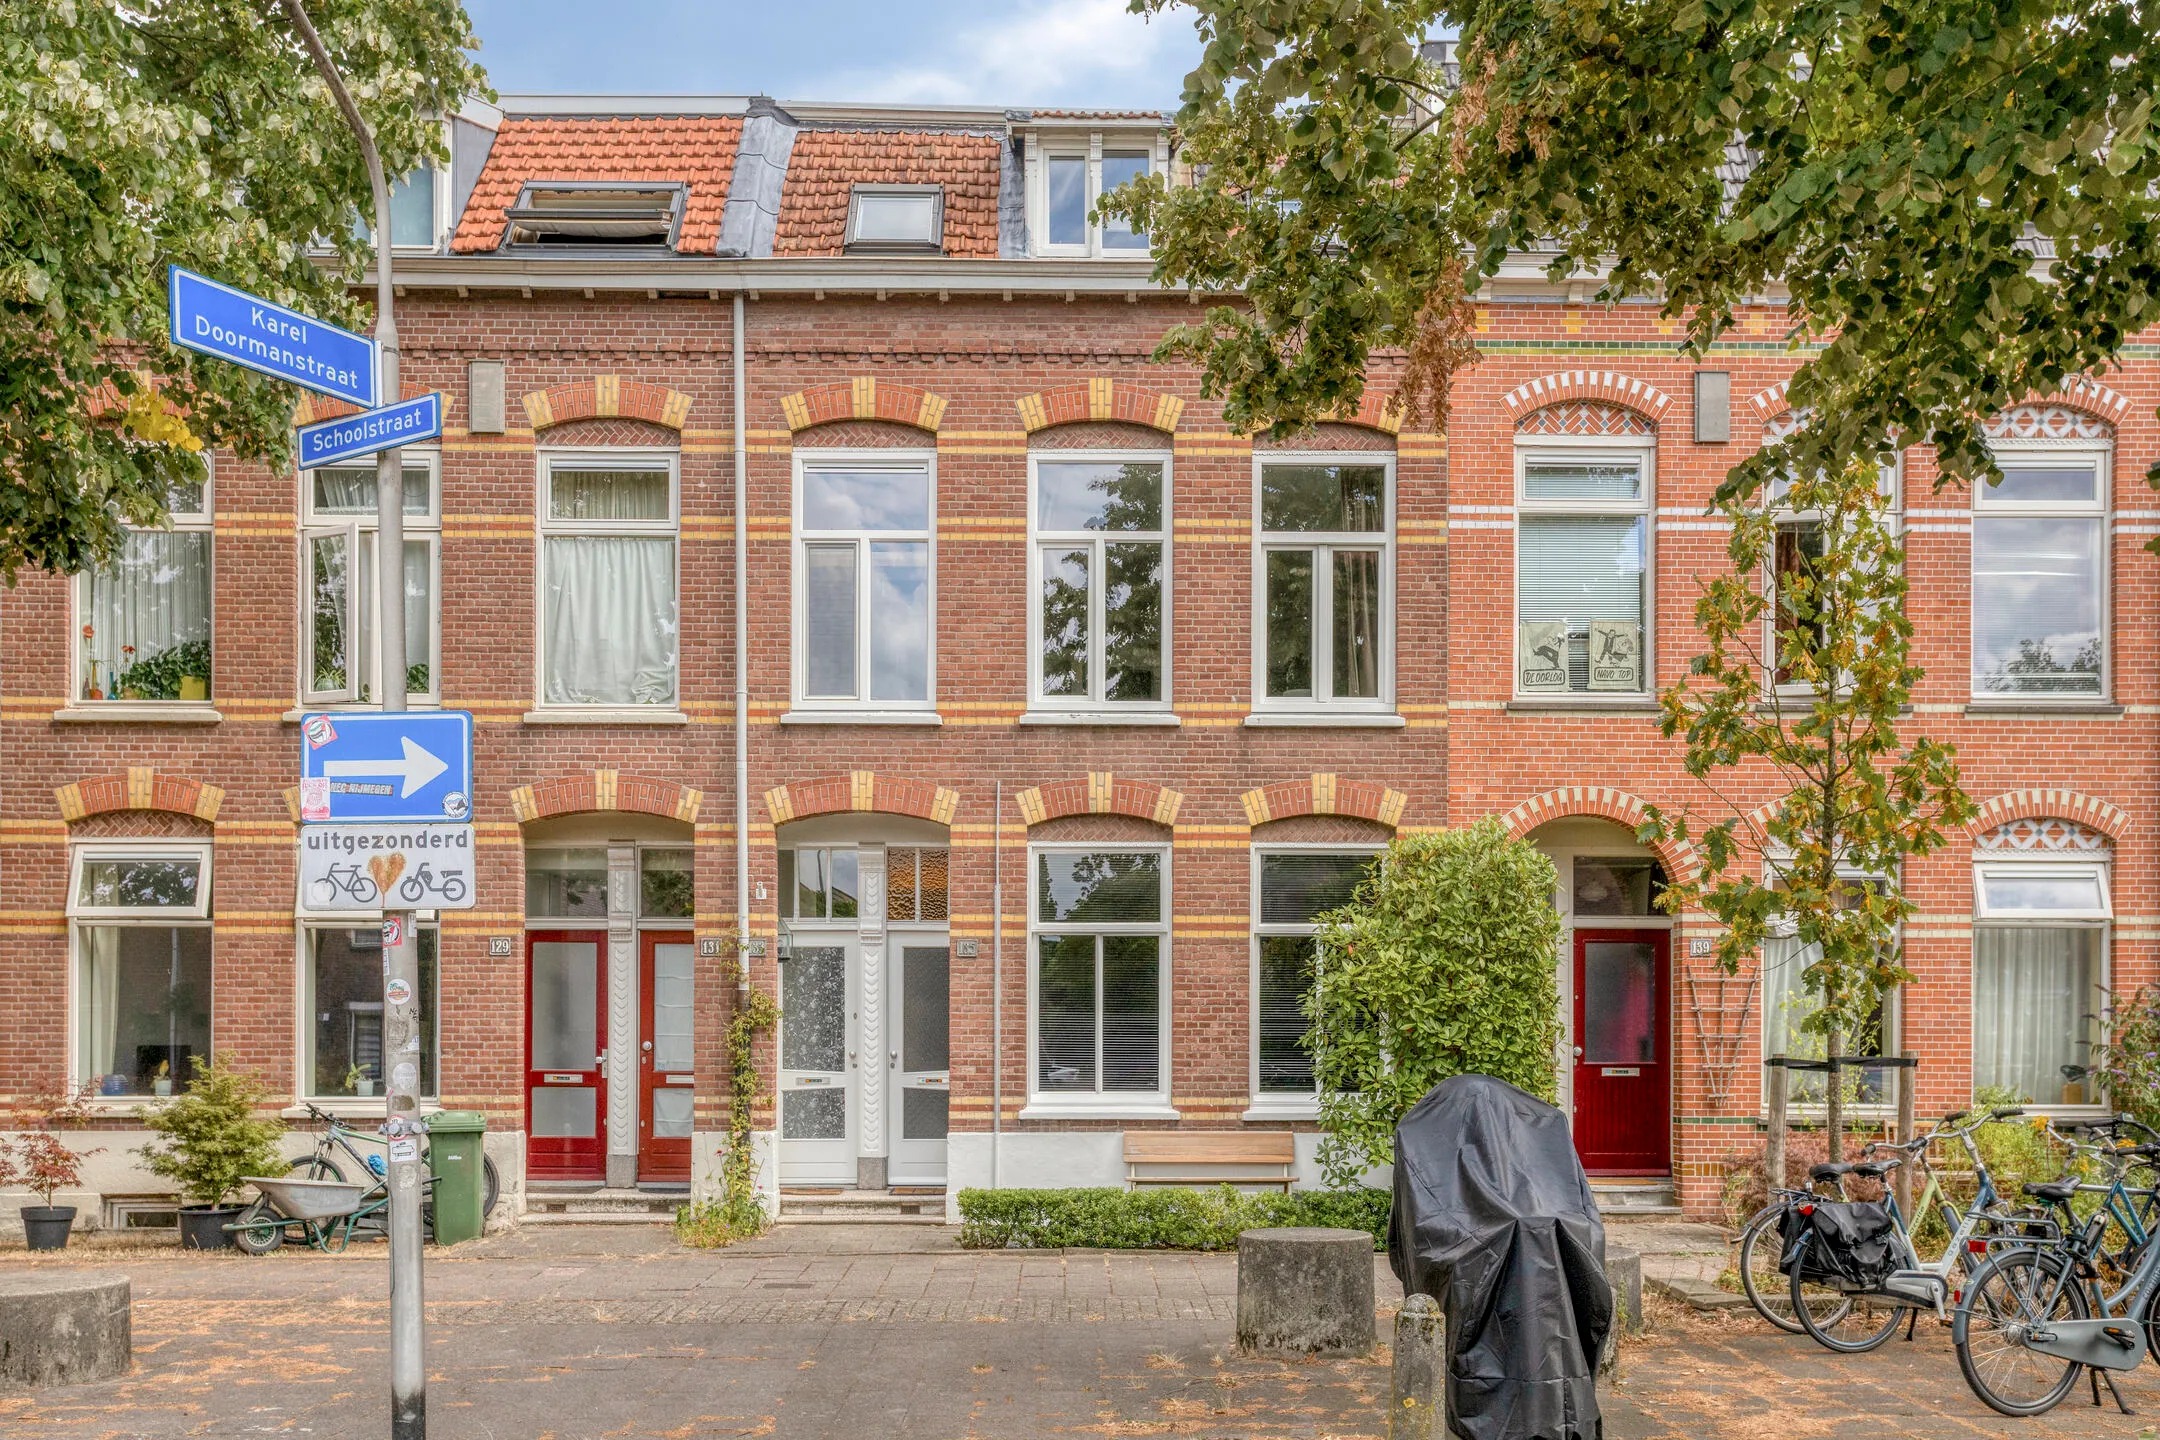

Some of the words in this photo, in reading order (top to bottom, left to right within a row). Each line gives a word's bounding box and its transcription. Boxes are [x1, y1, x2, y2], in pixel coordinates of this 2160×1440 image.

[251, 306, 307, 344] Karel
[195, 315, 358, 389] Doormanstraat
[313, 408, 421, 452] Schoolstraat
[307, 830, 468, 855] uitgezonderd
[491, 940, 509, 953] 129
[1692, 941, 1710, 954] 139
